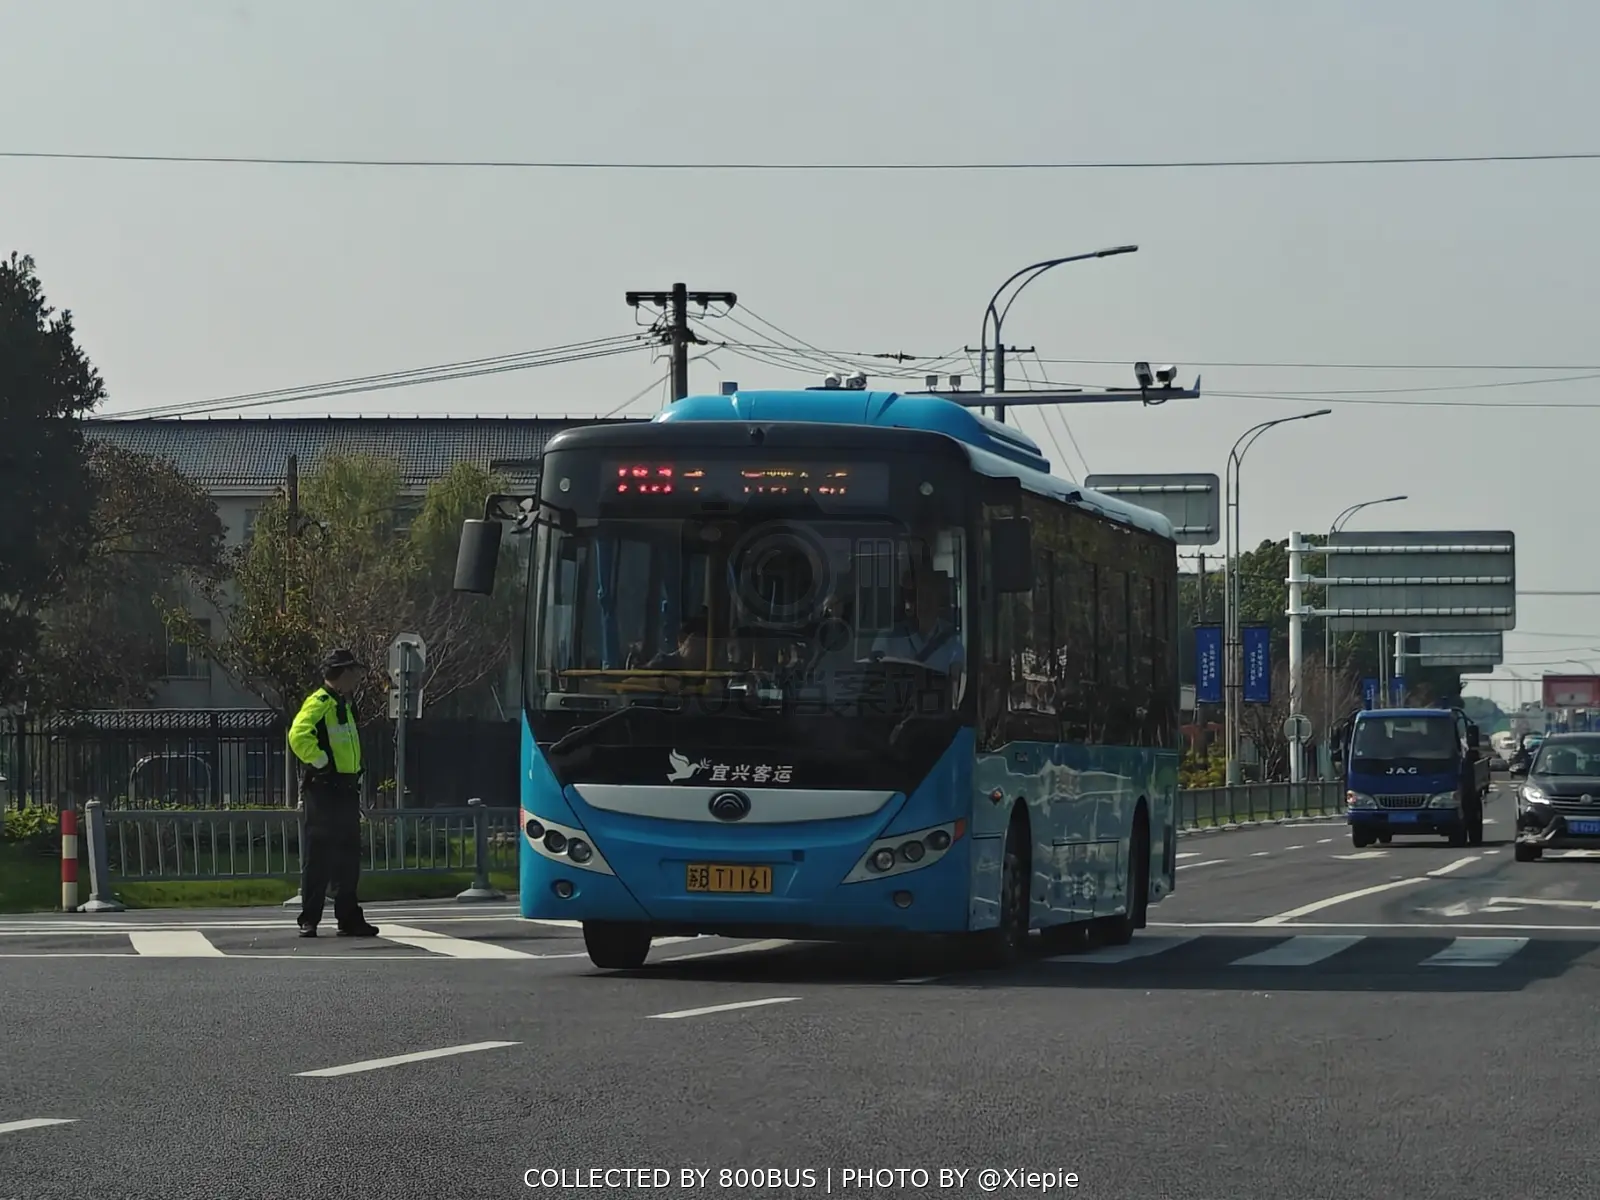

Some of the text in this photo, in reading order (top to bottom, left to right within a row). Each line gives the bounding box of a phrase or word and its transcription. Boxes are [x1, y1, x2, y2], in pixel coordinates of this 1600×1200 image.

[709, 764, 793, 783] 宜兴客运
[1385, 767, 1418, 775] JAC
